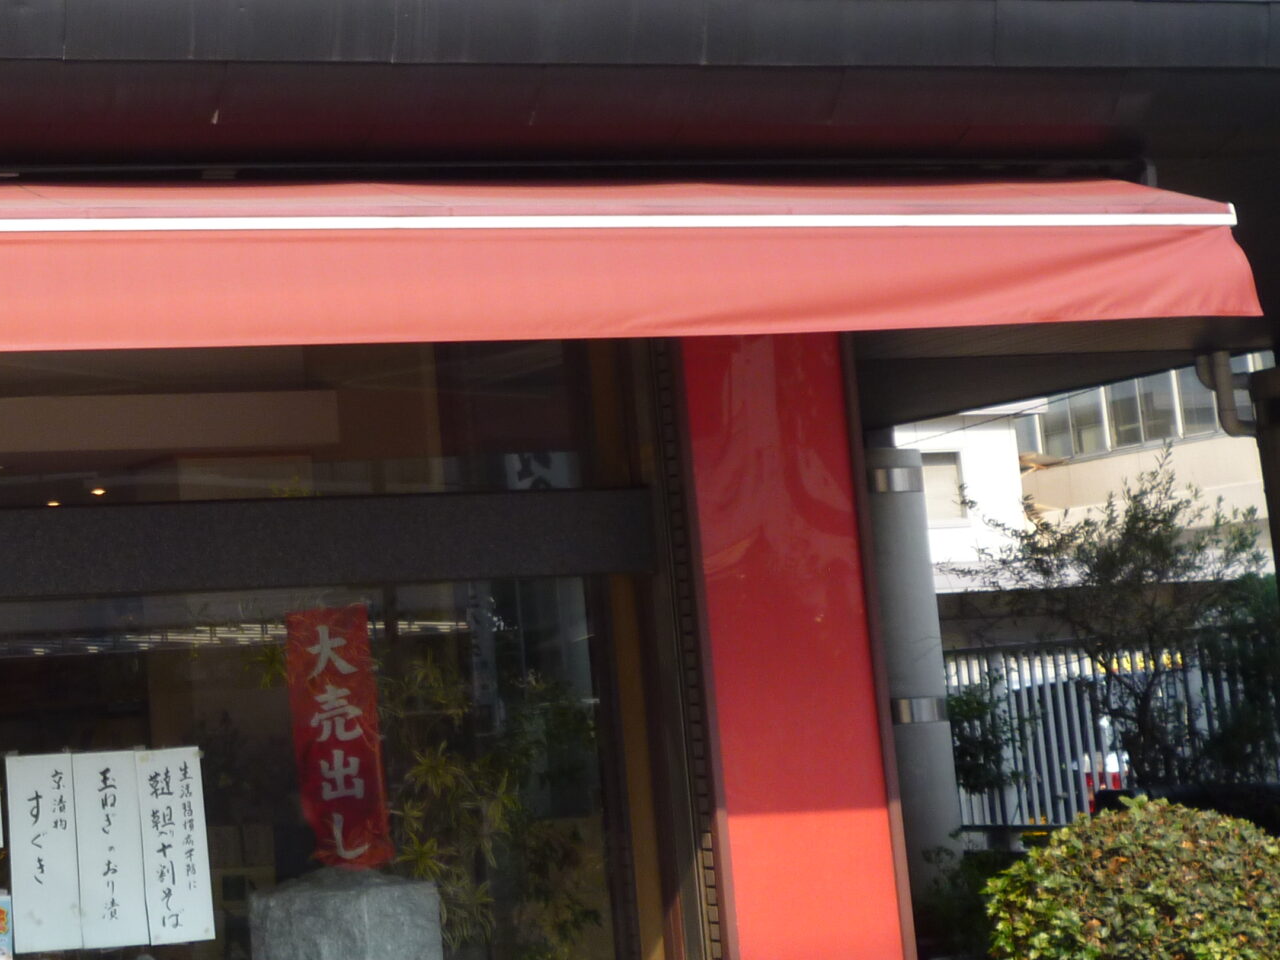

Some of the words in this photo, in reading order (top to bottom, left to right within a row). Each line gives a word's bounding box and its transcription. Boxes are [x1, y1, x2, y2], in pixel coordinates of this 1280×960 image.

[306, 625, 370, 860] 大売出し
[27, 791, 47, 885] すぐき
